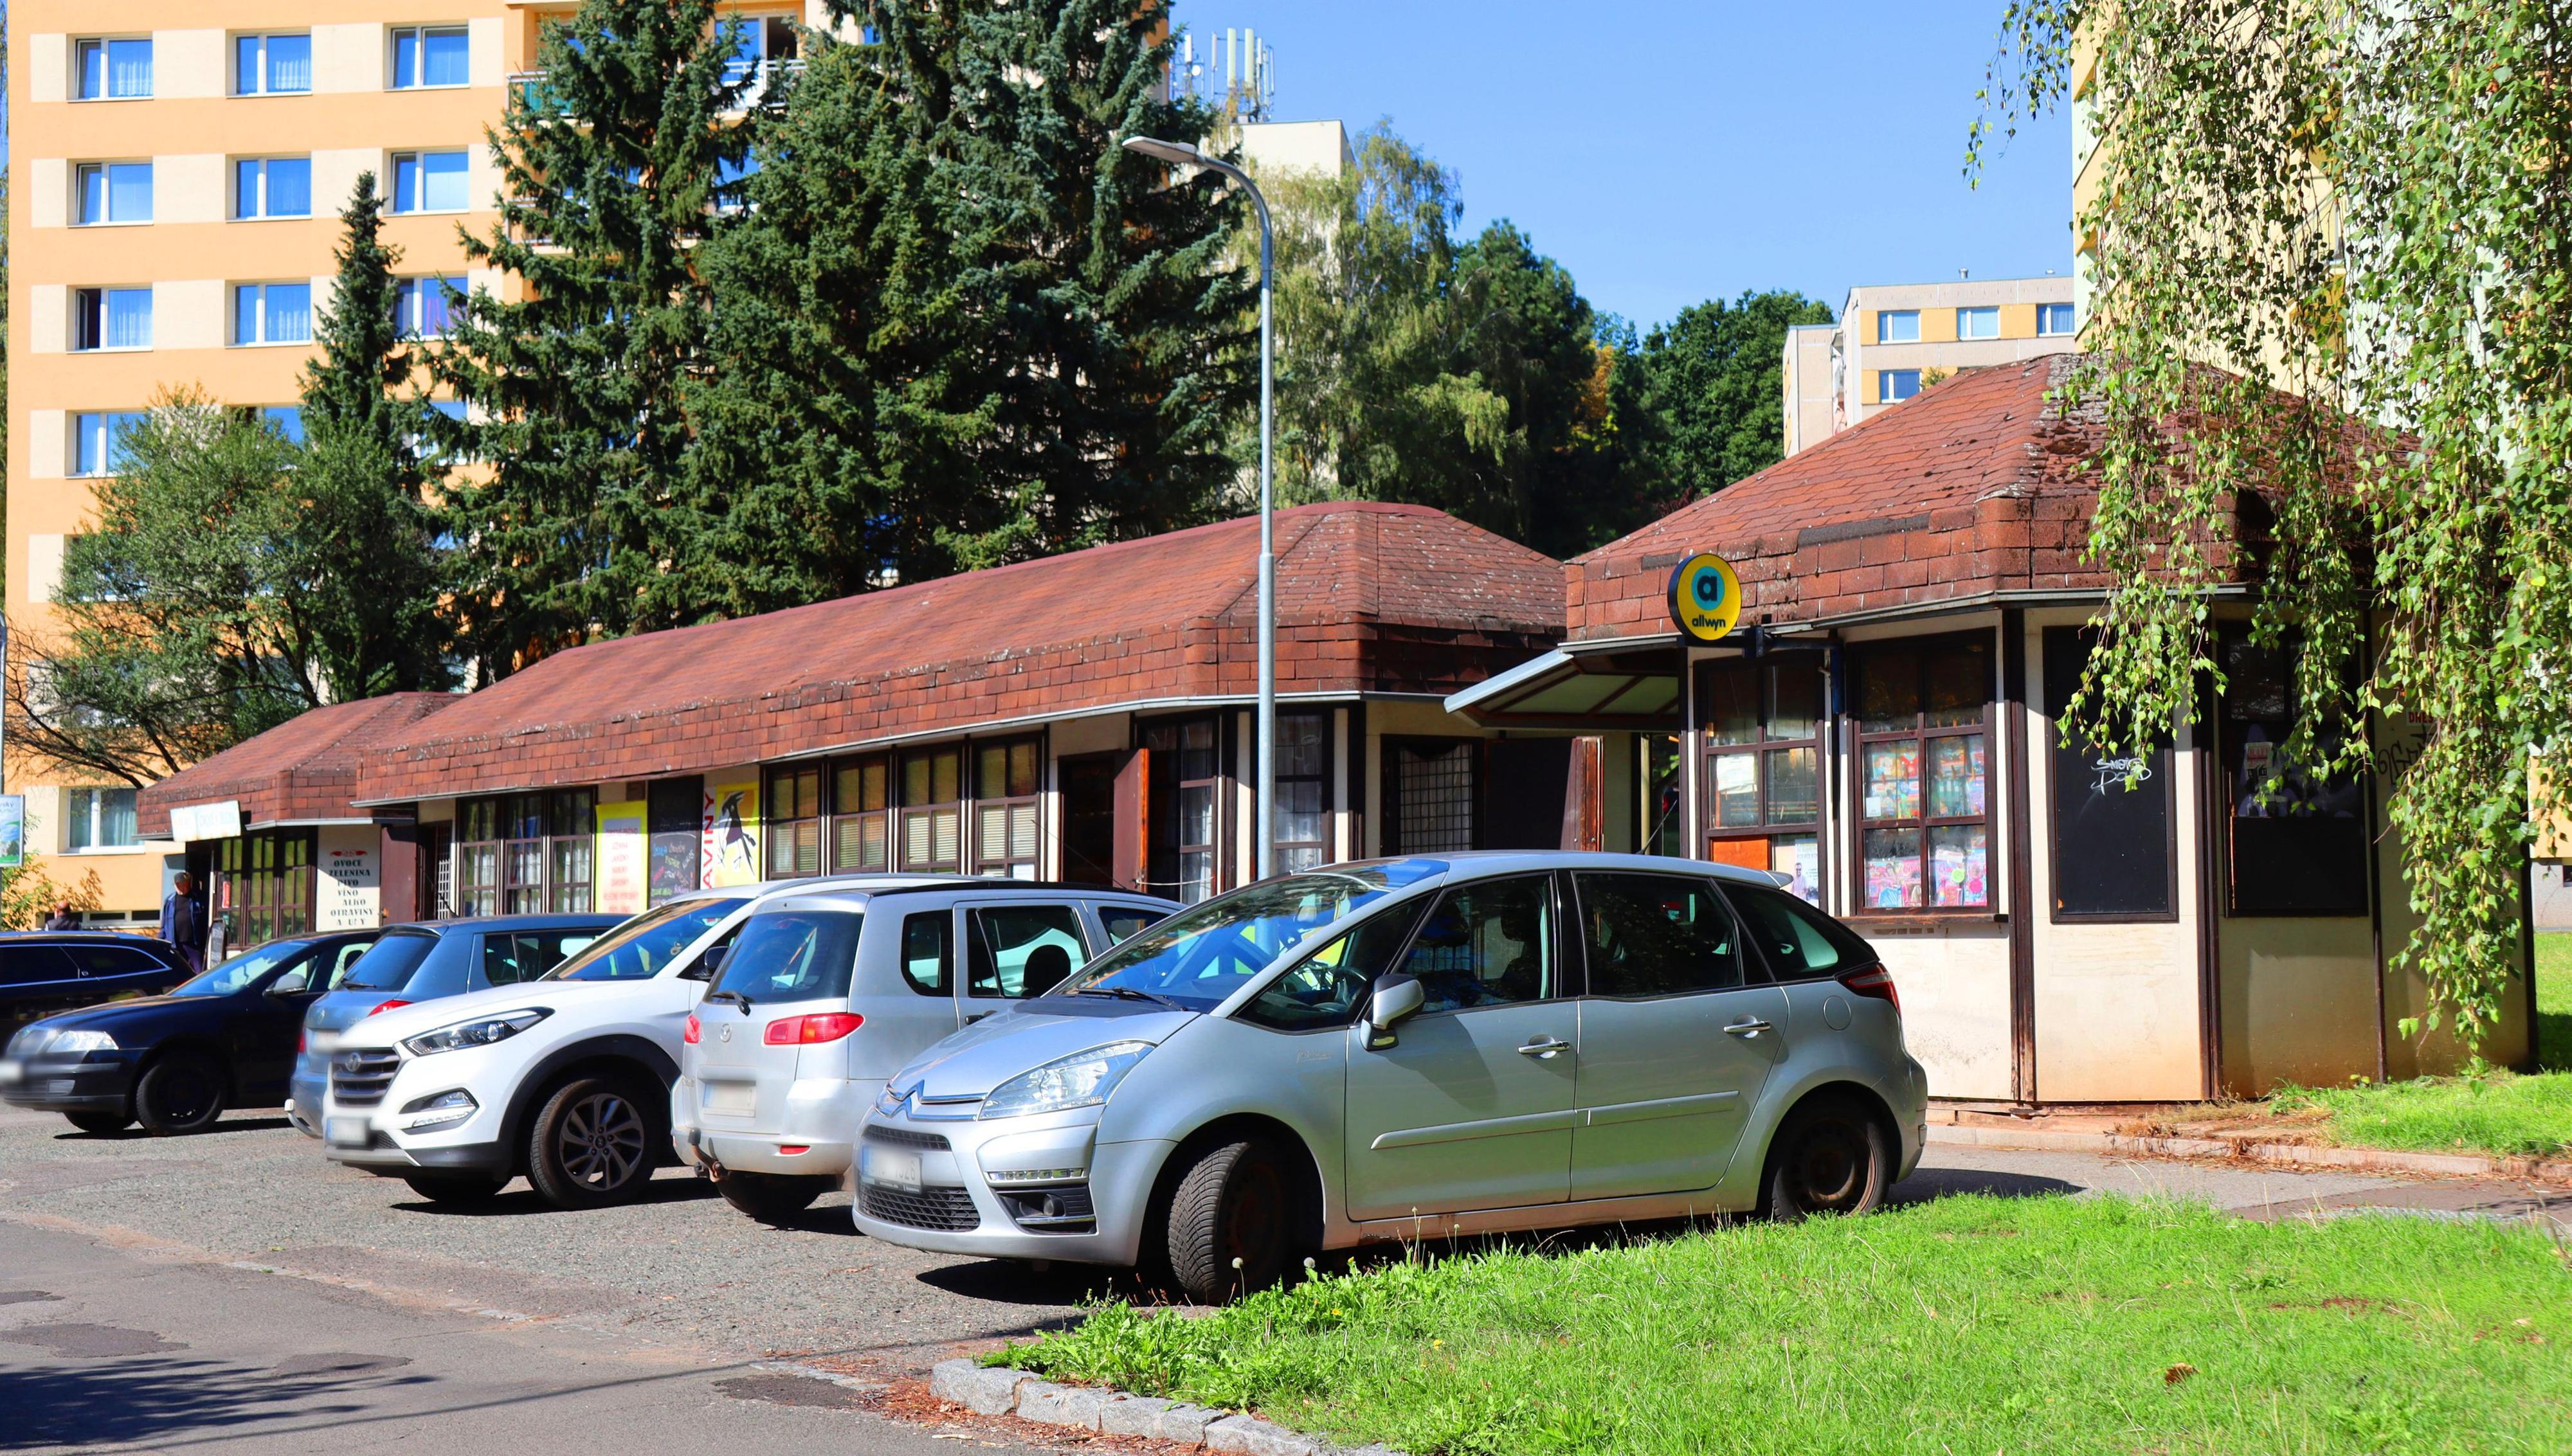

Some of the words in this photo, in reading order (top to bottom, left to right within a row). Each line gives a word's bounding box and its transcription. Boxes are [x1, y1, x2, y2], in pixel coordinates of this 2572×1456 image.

[1696, 575, 1718, 602] a
[1692, 615, 1726, 631] allwyn
[334, 859, 363, 867] OVOCE
